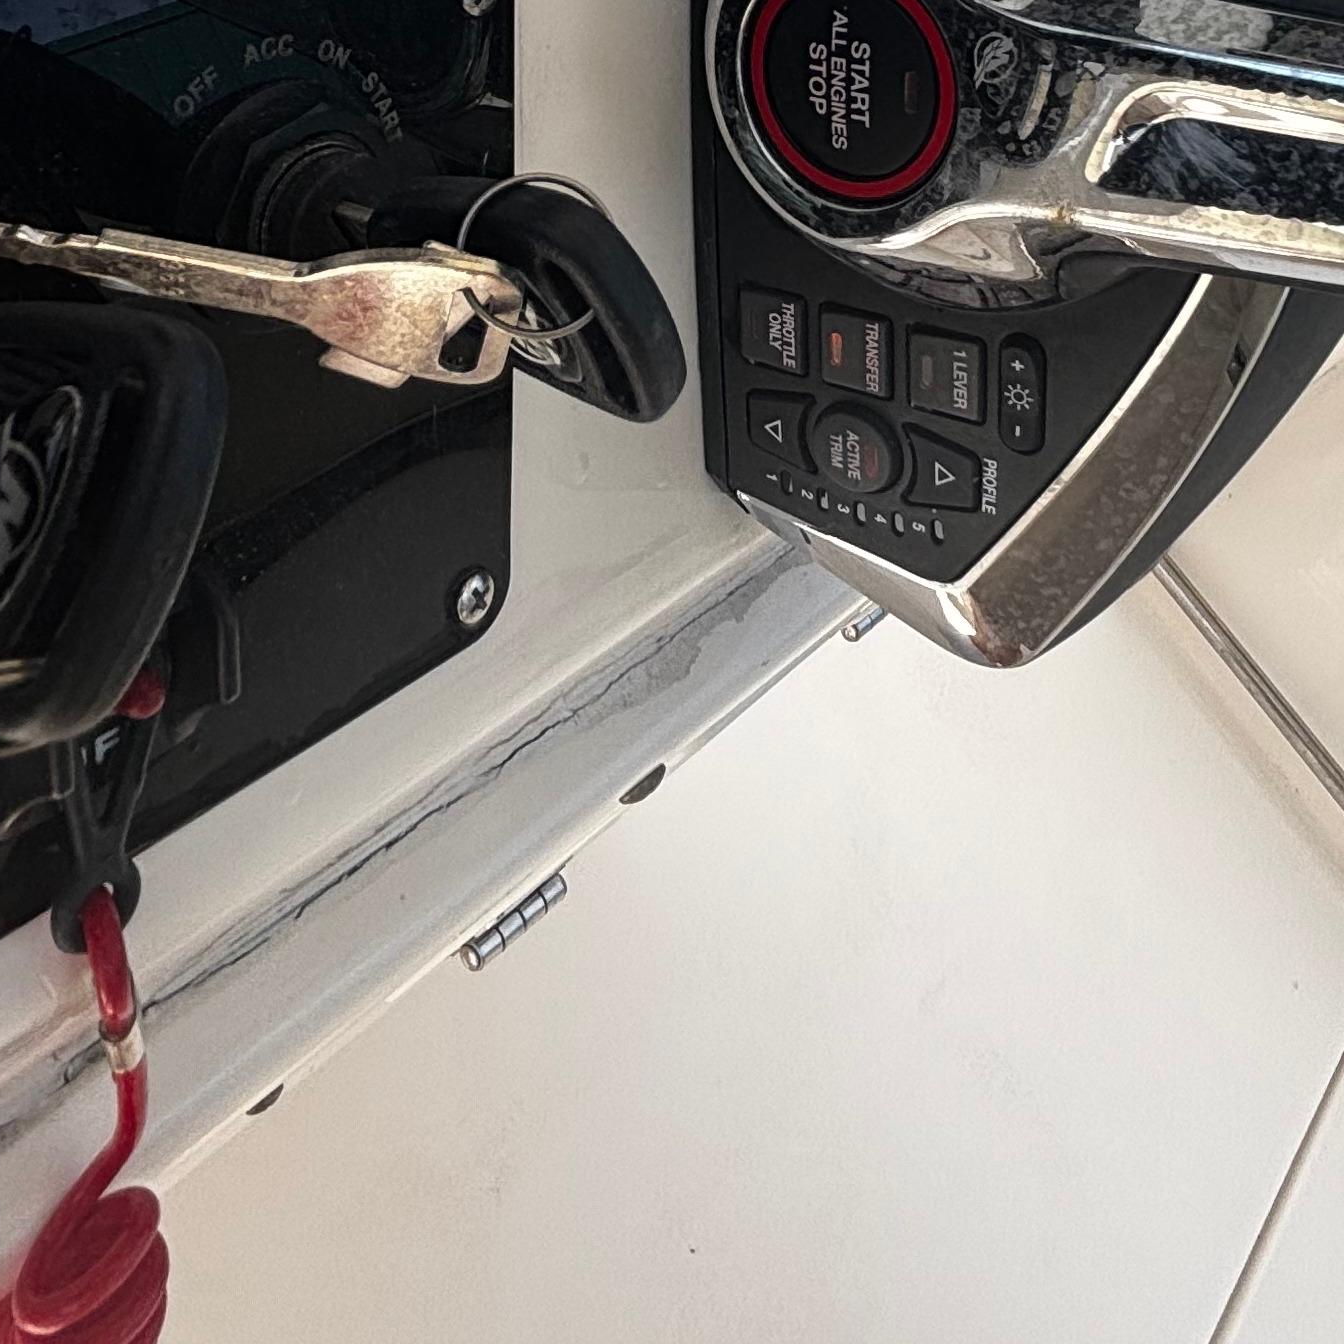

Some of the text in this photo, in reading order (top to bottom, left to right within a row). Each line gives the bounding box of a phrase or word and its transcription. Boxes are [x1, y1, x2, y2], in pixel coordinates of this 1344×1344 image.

[243, 34, 294, 68] ACC
[318, 39, 352, 71] ON
[808, 42, 827, 116] STOP
[831, 9, 849, 151] ALL ENGINES
[173, 65, 218, 119] OFF
[361, 71, 403, 143] START
[851, 41, 871, 128] START
[768, 313, 782, 352] ONLY
[781, 303, 796, 369] THROTTLE
[864, 322, 879, 393] TRANSFER
[953, 362, 968, 409] LEVER
[829, 433, 843, 470] TRIM
[846, 430, 861, 481] ACTIVE
[766, 473, 926, 534] 1 2 3 4 5
[981, 457, 997, 515] PROFILE
